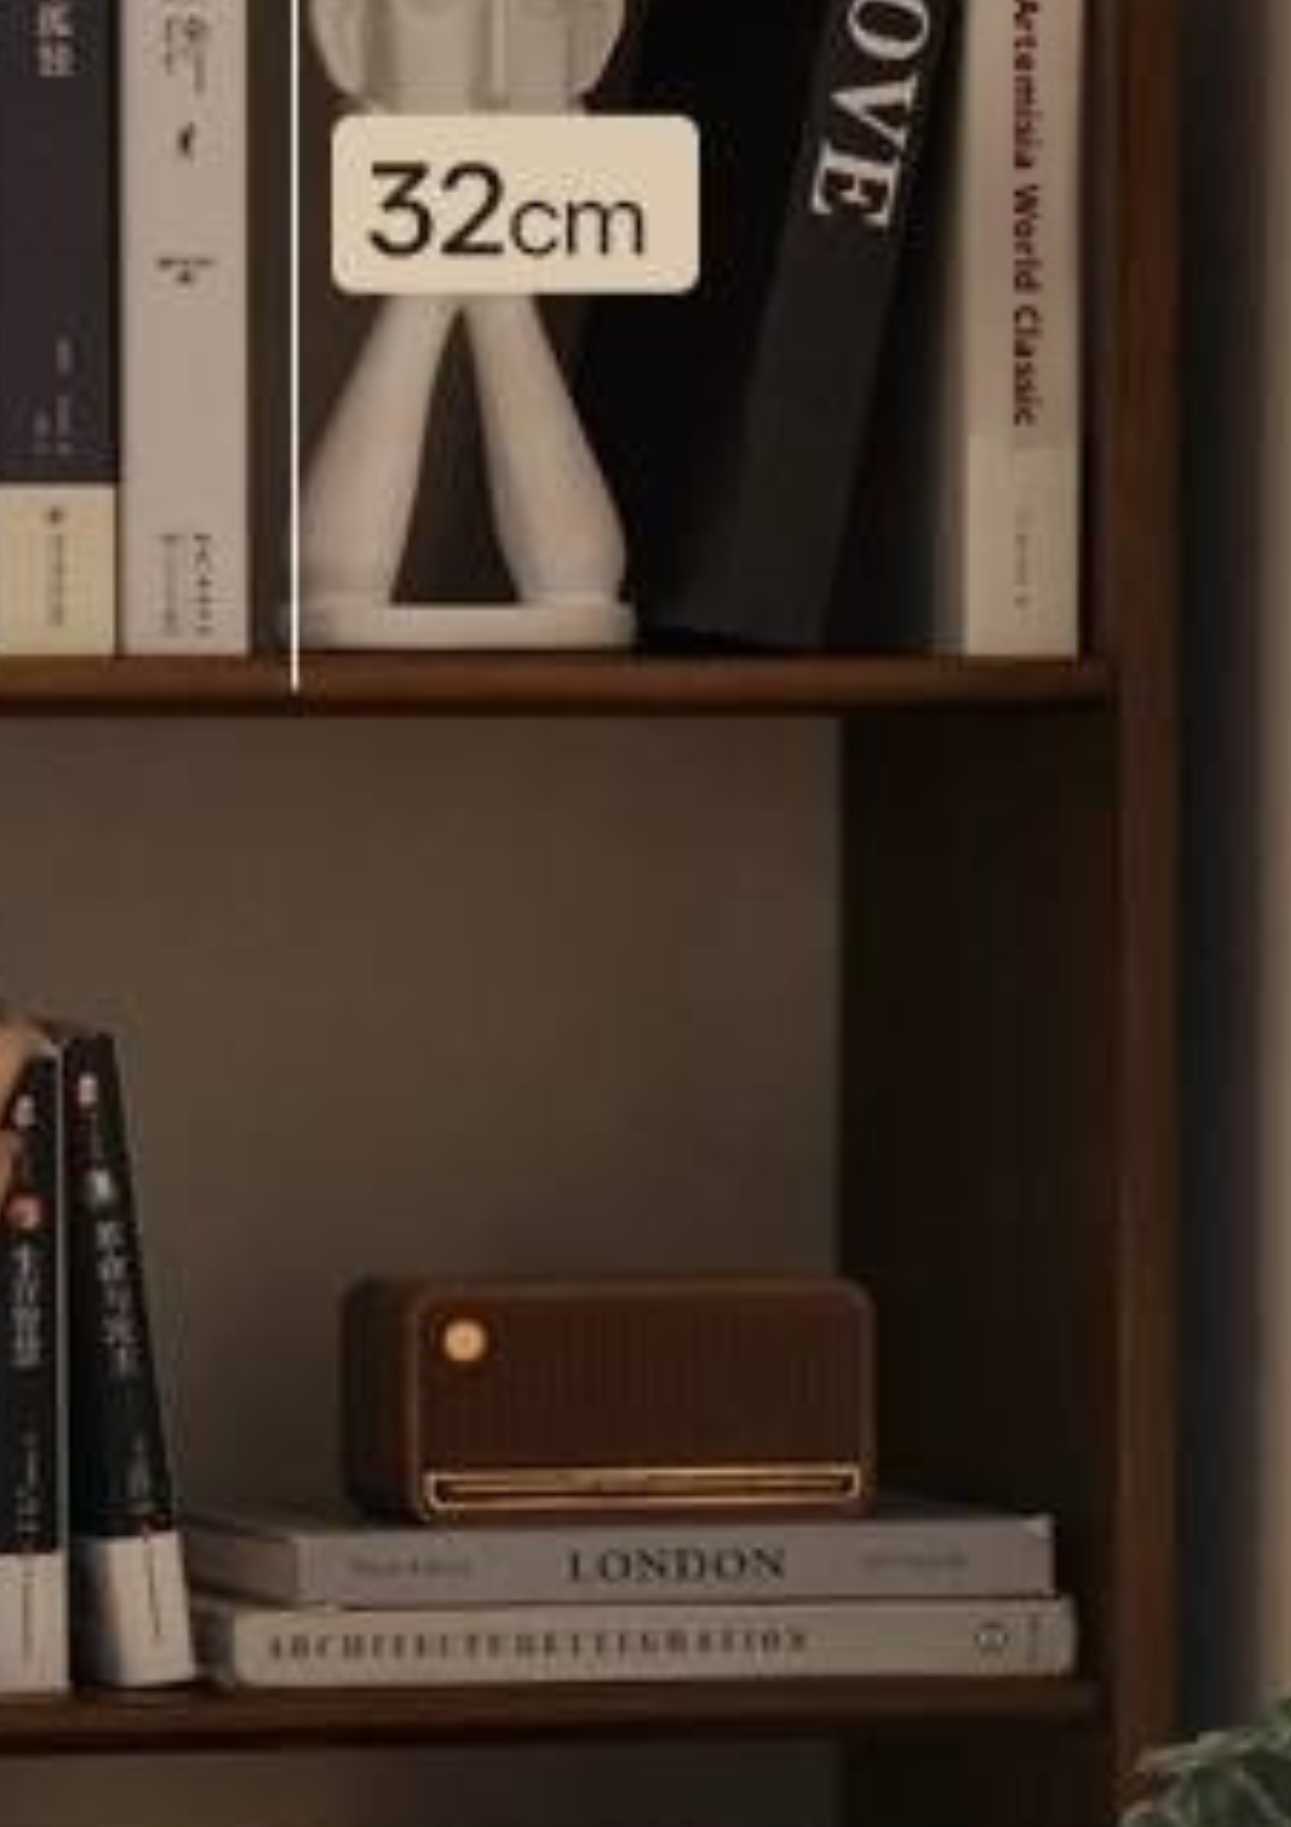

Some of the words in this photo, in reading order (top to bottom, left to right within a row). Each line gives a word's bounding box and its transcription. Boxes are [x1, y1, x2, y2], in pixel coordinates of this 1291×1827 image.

[1011, 183, 1046, 293] World
[1011, 305, 1046, 427] Classic
[566, 1546, 787, 1585] LONDON
